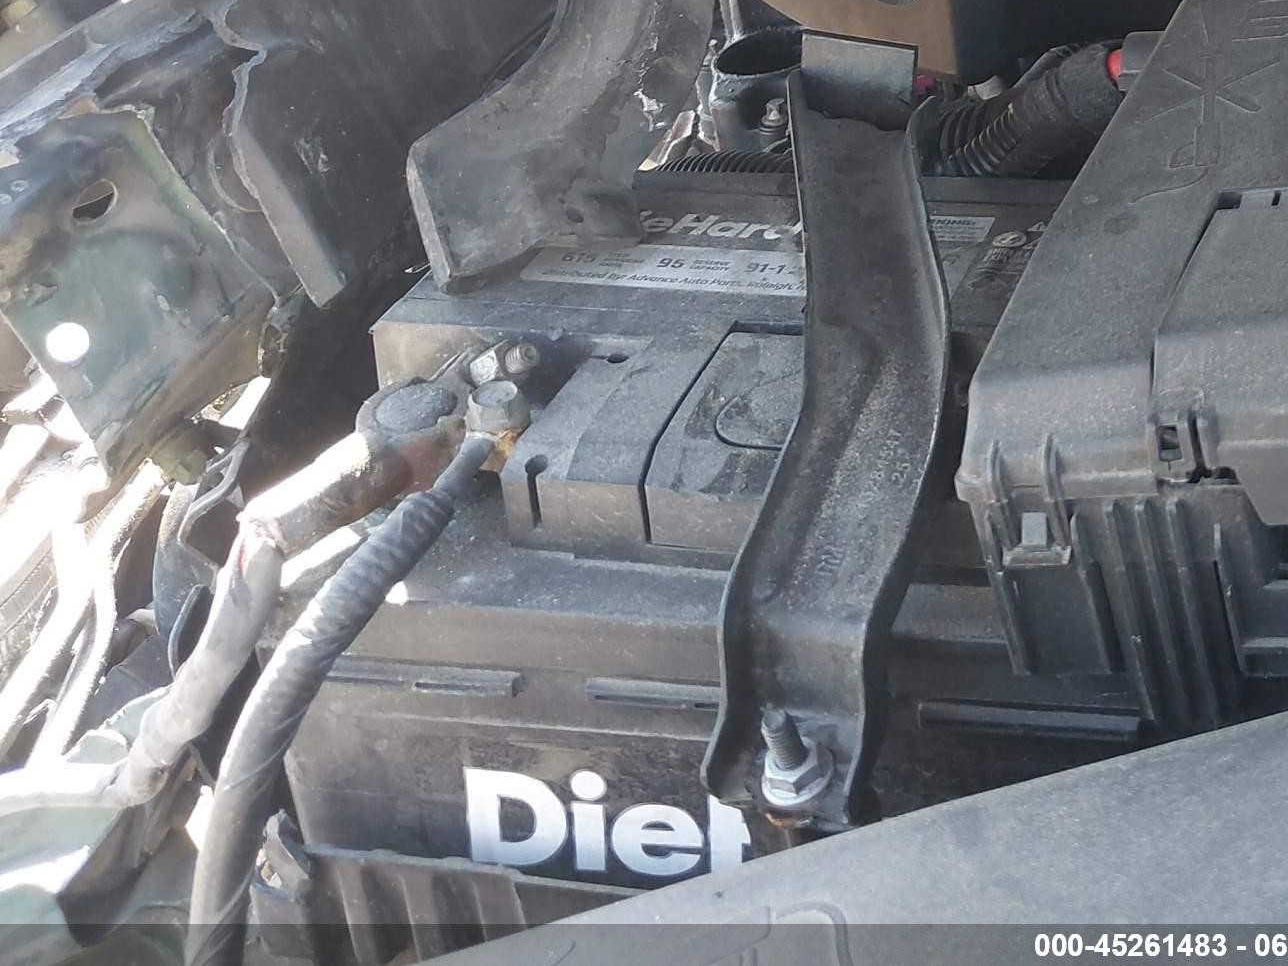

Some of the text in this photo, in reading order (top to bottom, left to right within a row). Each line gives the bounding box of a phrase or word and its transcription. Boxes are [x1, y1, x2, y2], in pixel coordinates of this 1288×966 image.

[640, 210, 803, 240] eHard
[561, 252, 596, 263] 615
[656, 257, 687, 269] 95
[607, 273, 627, 281] by:
[627, 274, 678, 284] Advance
[679, 277, 710, 286] Auto
